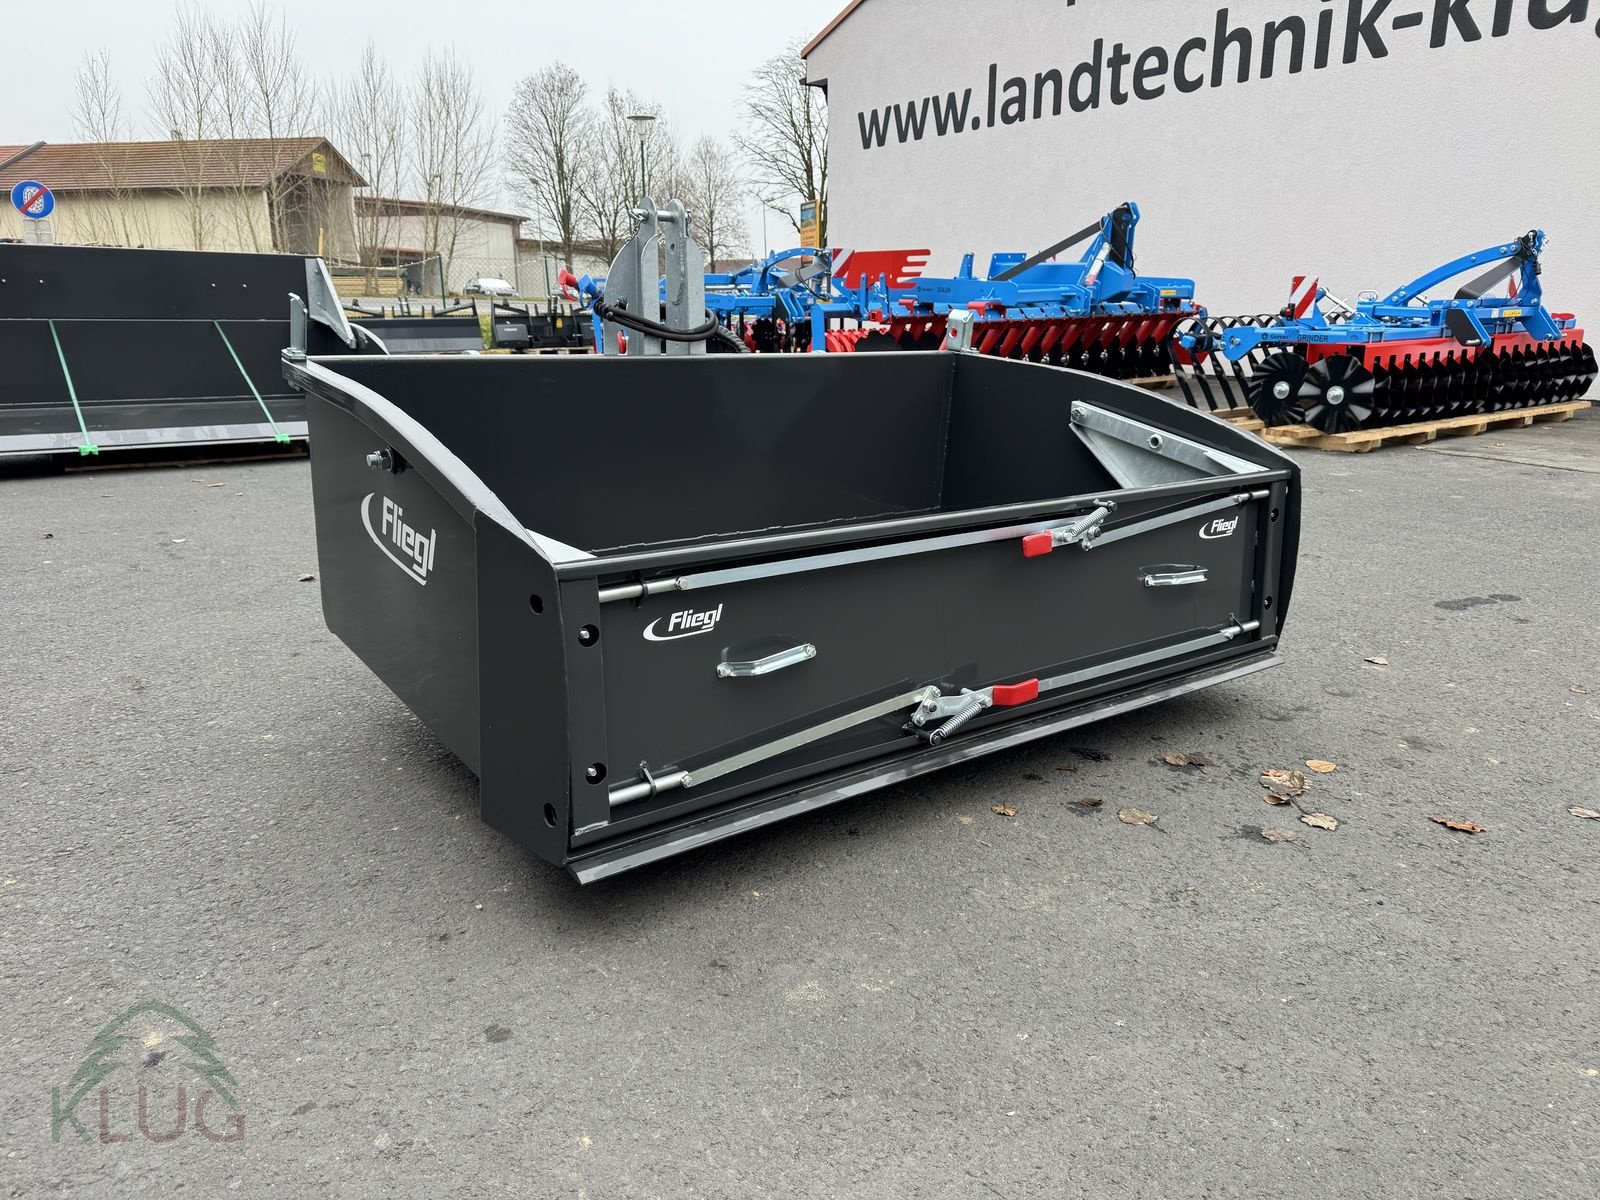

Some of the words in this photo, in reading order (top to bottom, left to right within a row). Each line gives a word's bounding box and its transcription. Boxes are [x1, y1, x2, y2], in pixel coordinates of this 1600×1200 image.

[1297, 334, 1329, 343] GRINDER
[381, 495, 437, 578] Fliegl
[1210, 516, 1239, 534] Fliegl
[667, 603, 723, 632] Fliegl
